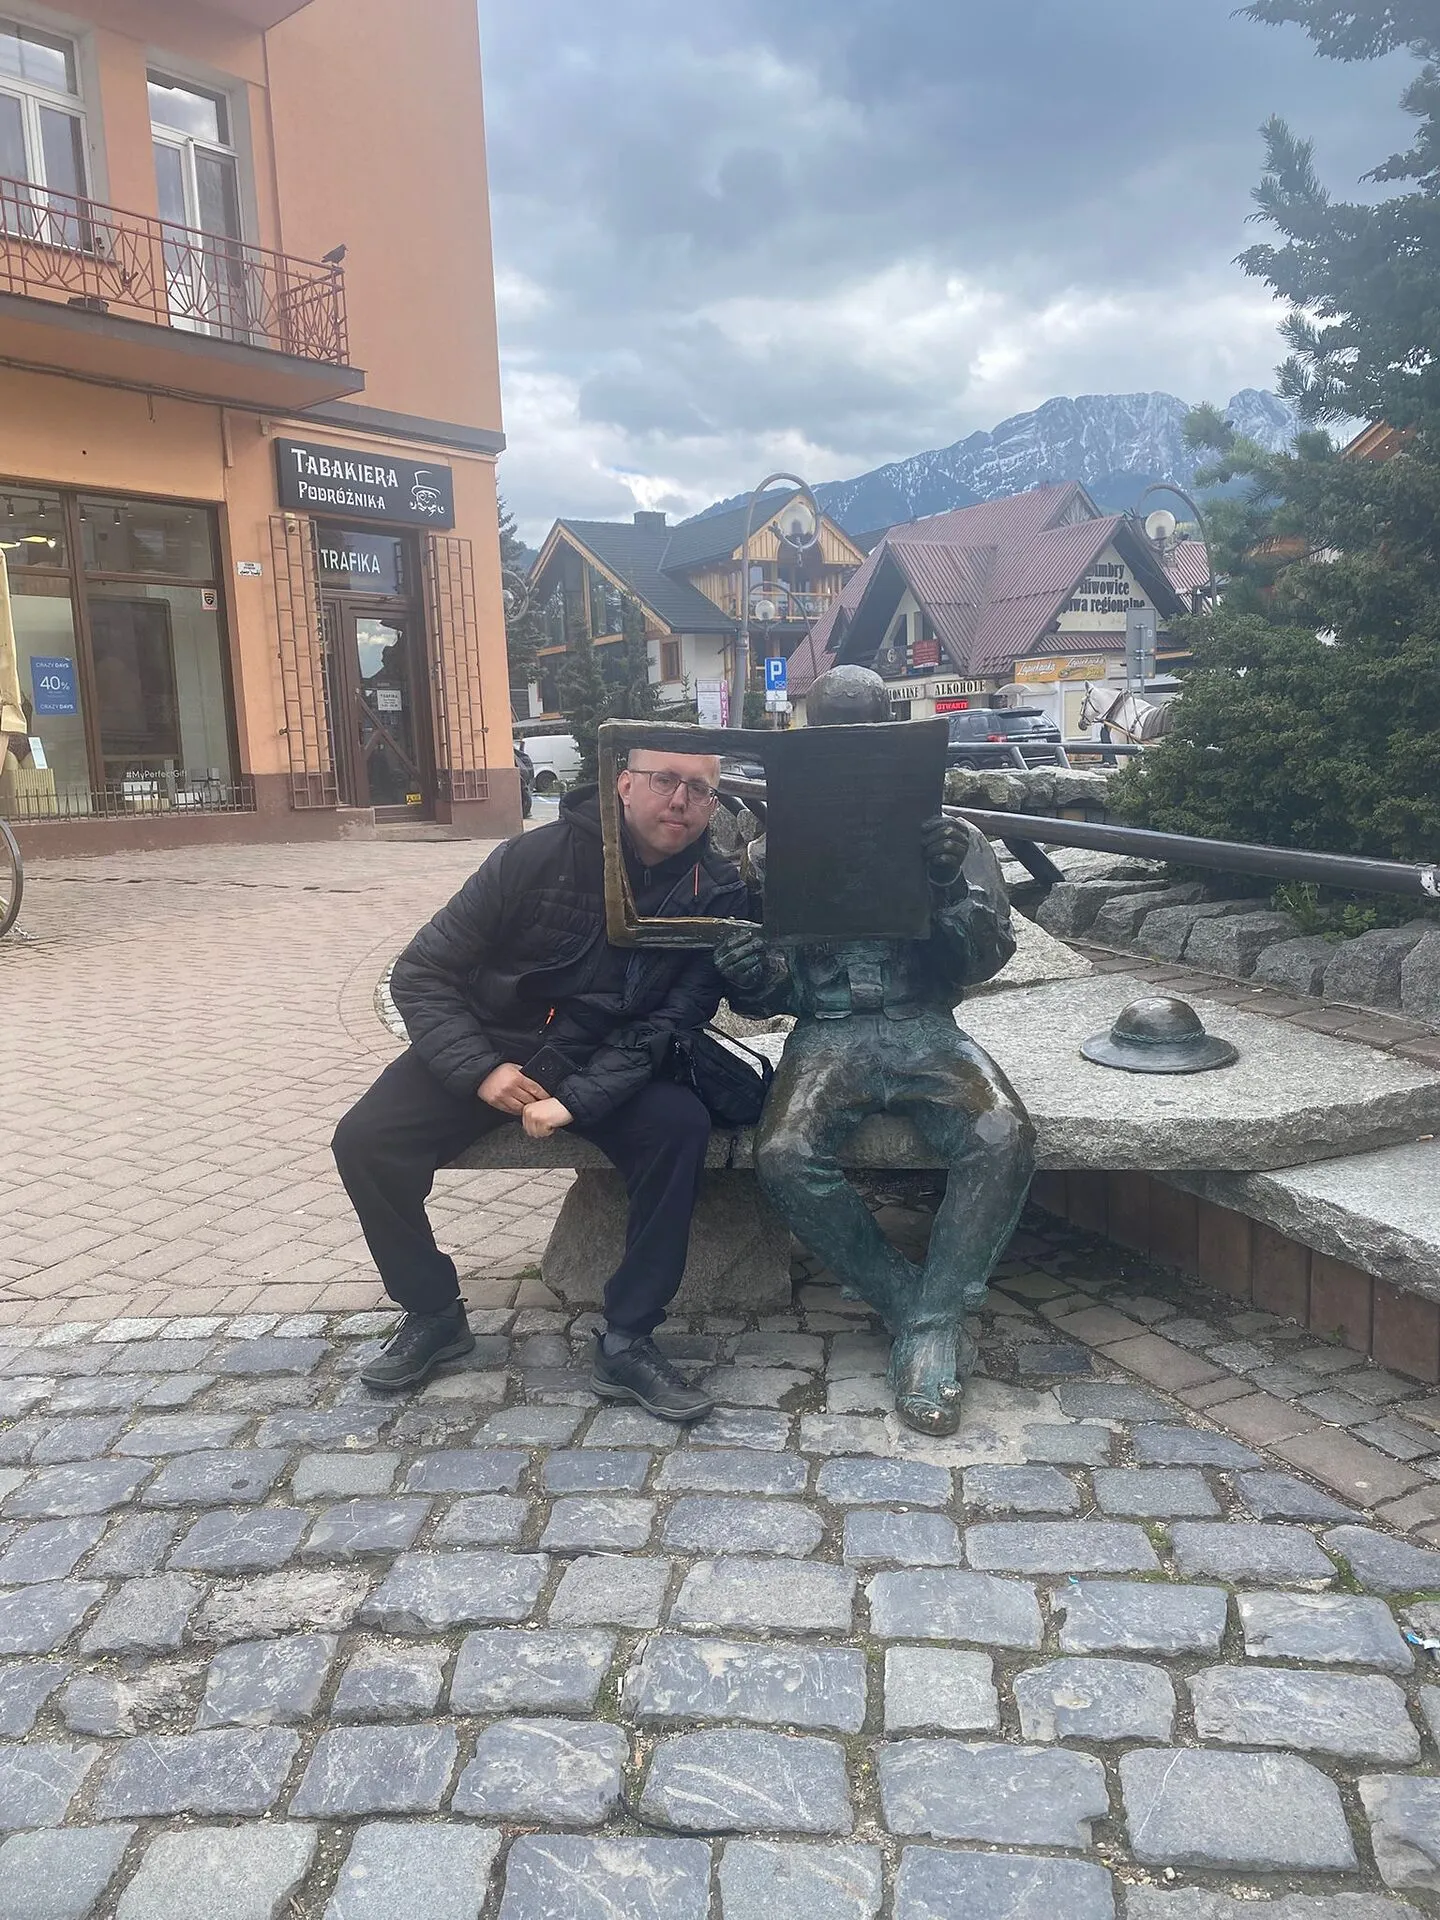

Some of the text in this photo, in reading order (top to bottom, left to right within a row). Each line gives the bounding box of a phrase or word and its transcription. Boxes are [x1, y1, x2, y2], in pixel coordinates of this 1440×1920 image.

[291, 448, 399, 488] TABAKIERA
[299, 481, 386, 510] PODRÓŻNIKA
[320, 549, 381, 574] TRAFIKA
[770, 661, 782, 681] P
[40, 676, 71, 690] 40%
[935, 680, 985, 697] ALKOHOLE
